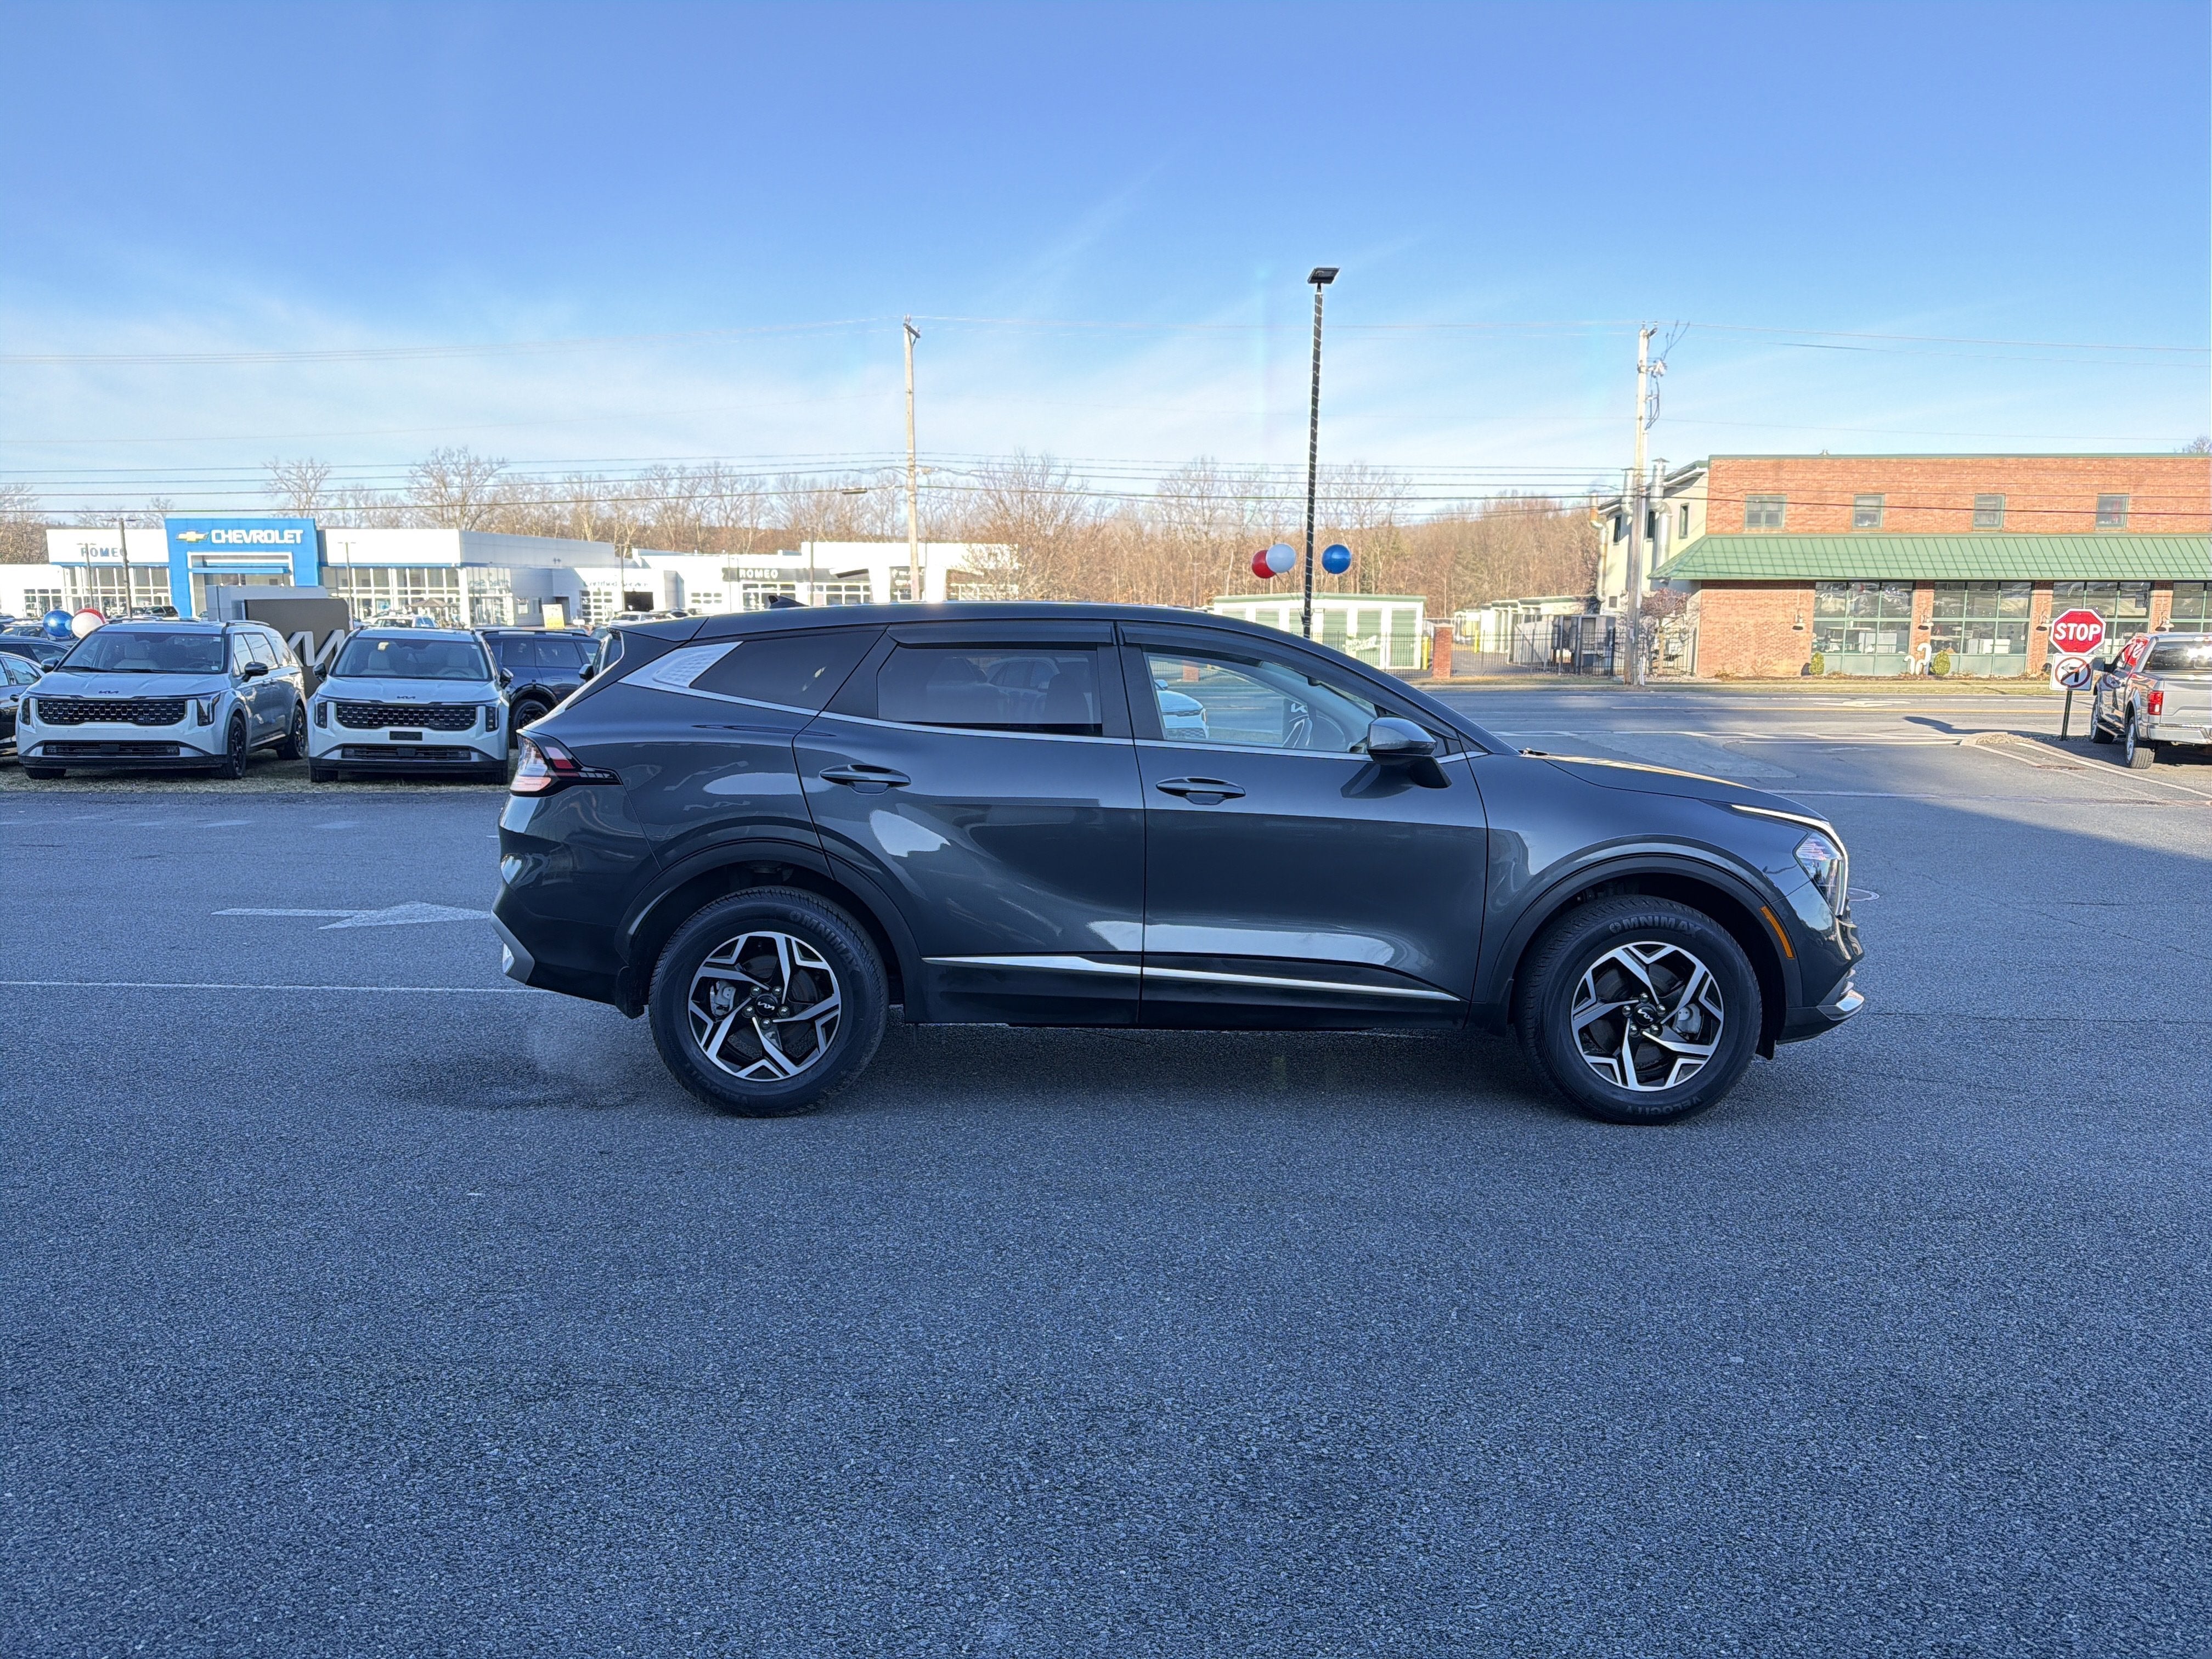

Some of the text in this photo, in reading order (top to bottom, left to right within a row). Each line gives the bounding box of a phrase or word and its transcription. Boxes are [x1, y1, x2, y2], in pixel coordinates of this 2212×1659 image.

[211, 529, 303, 544] CHEVROLET
[739, 569, 778, 579] ROMEO
[2055, 623, 2101, 641] STOP
[1609, 916, 1702, 938] OMNIMAX
[789, 911, 861, 974] OMNIMAX
[1626, 1096, 1702, 1115] VELOCITY
